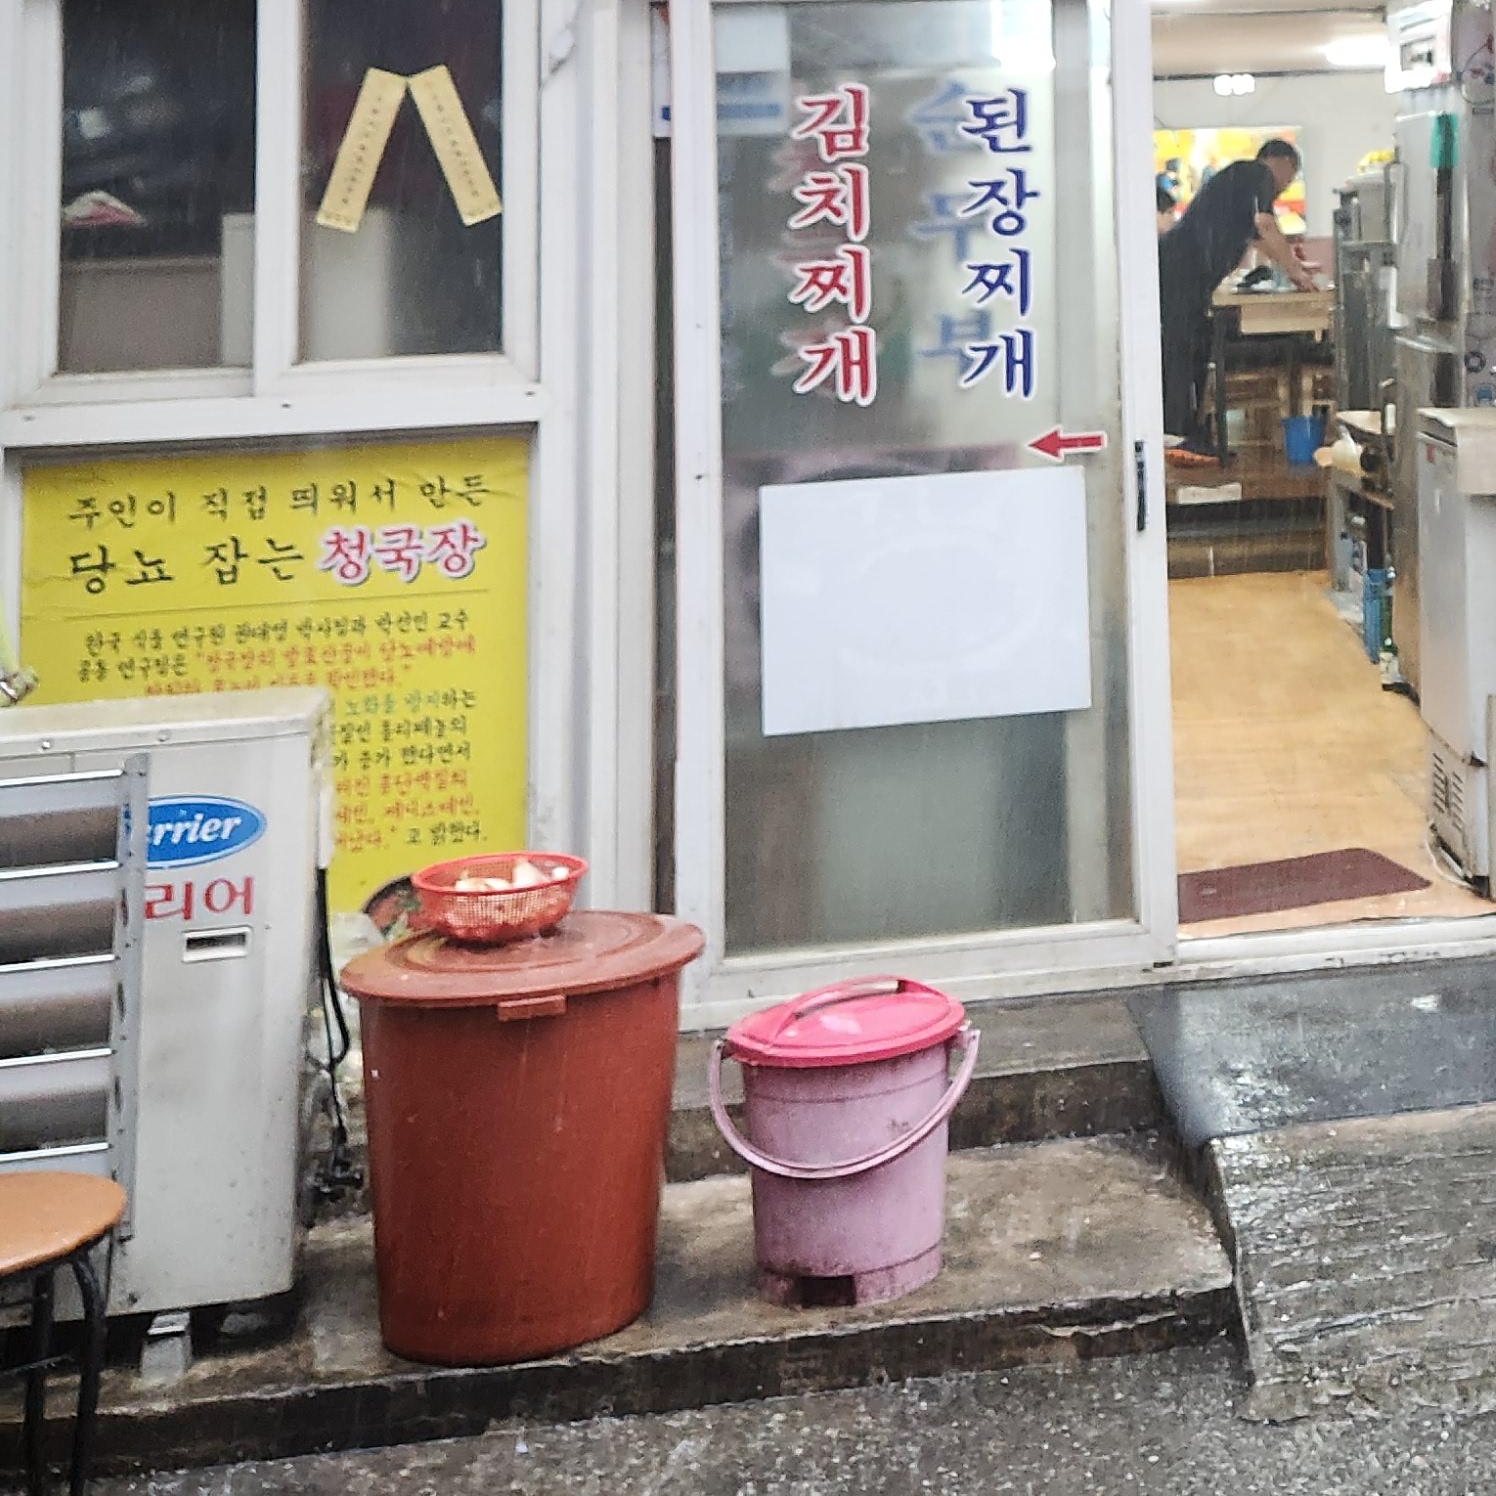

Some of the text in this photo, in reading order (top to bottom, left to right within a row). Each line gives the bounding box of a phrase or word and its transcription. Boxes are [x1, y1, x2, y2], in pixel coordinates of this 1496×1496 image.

[790, 82, 877, 407] 김치찌개
[961, 86, 1040, 400] 된장찌개
[69, 491, 175, 529] 주인이
[203, 487, 268, 520] 직접
[419, 474, 489, 508] 만든
[70, 524, 480, 594] 당뇨 잡는 청국장
